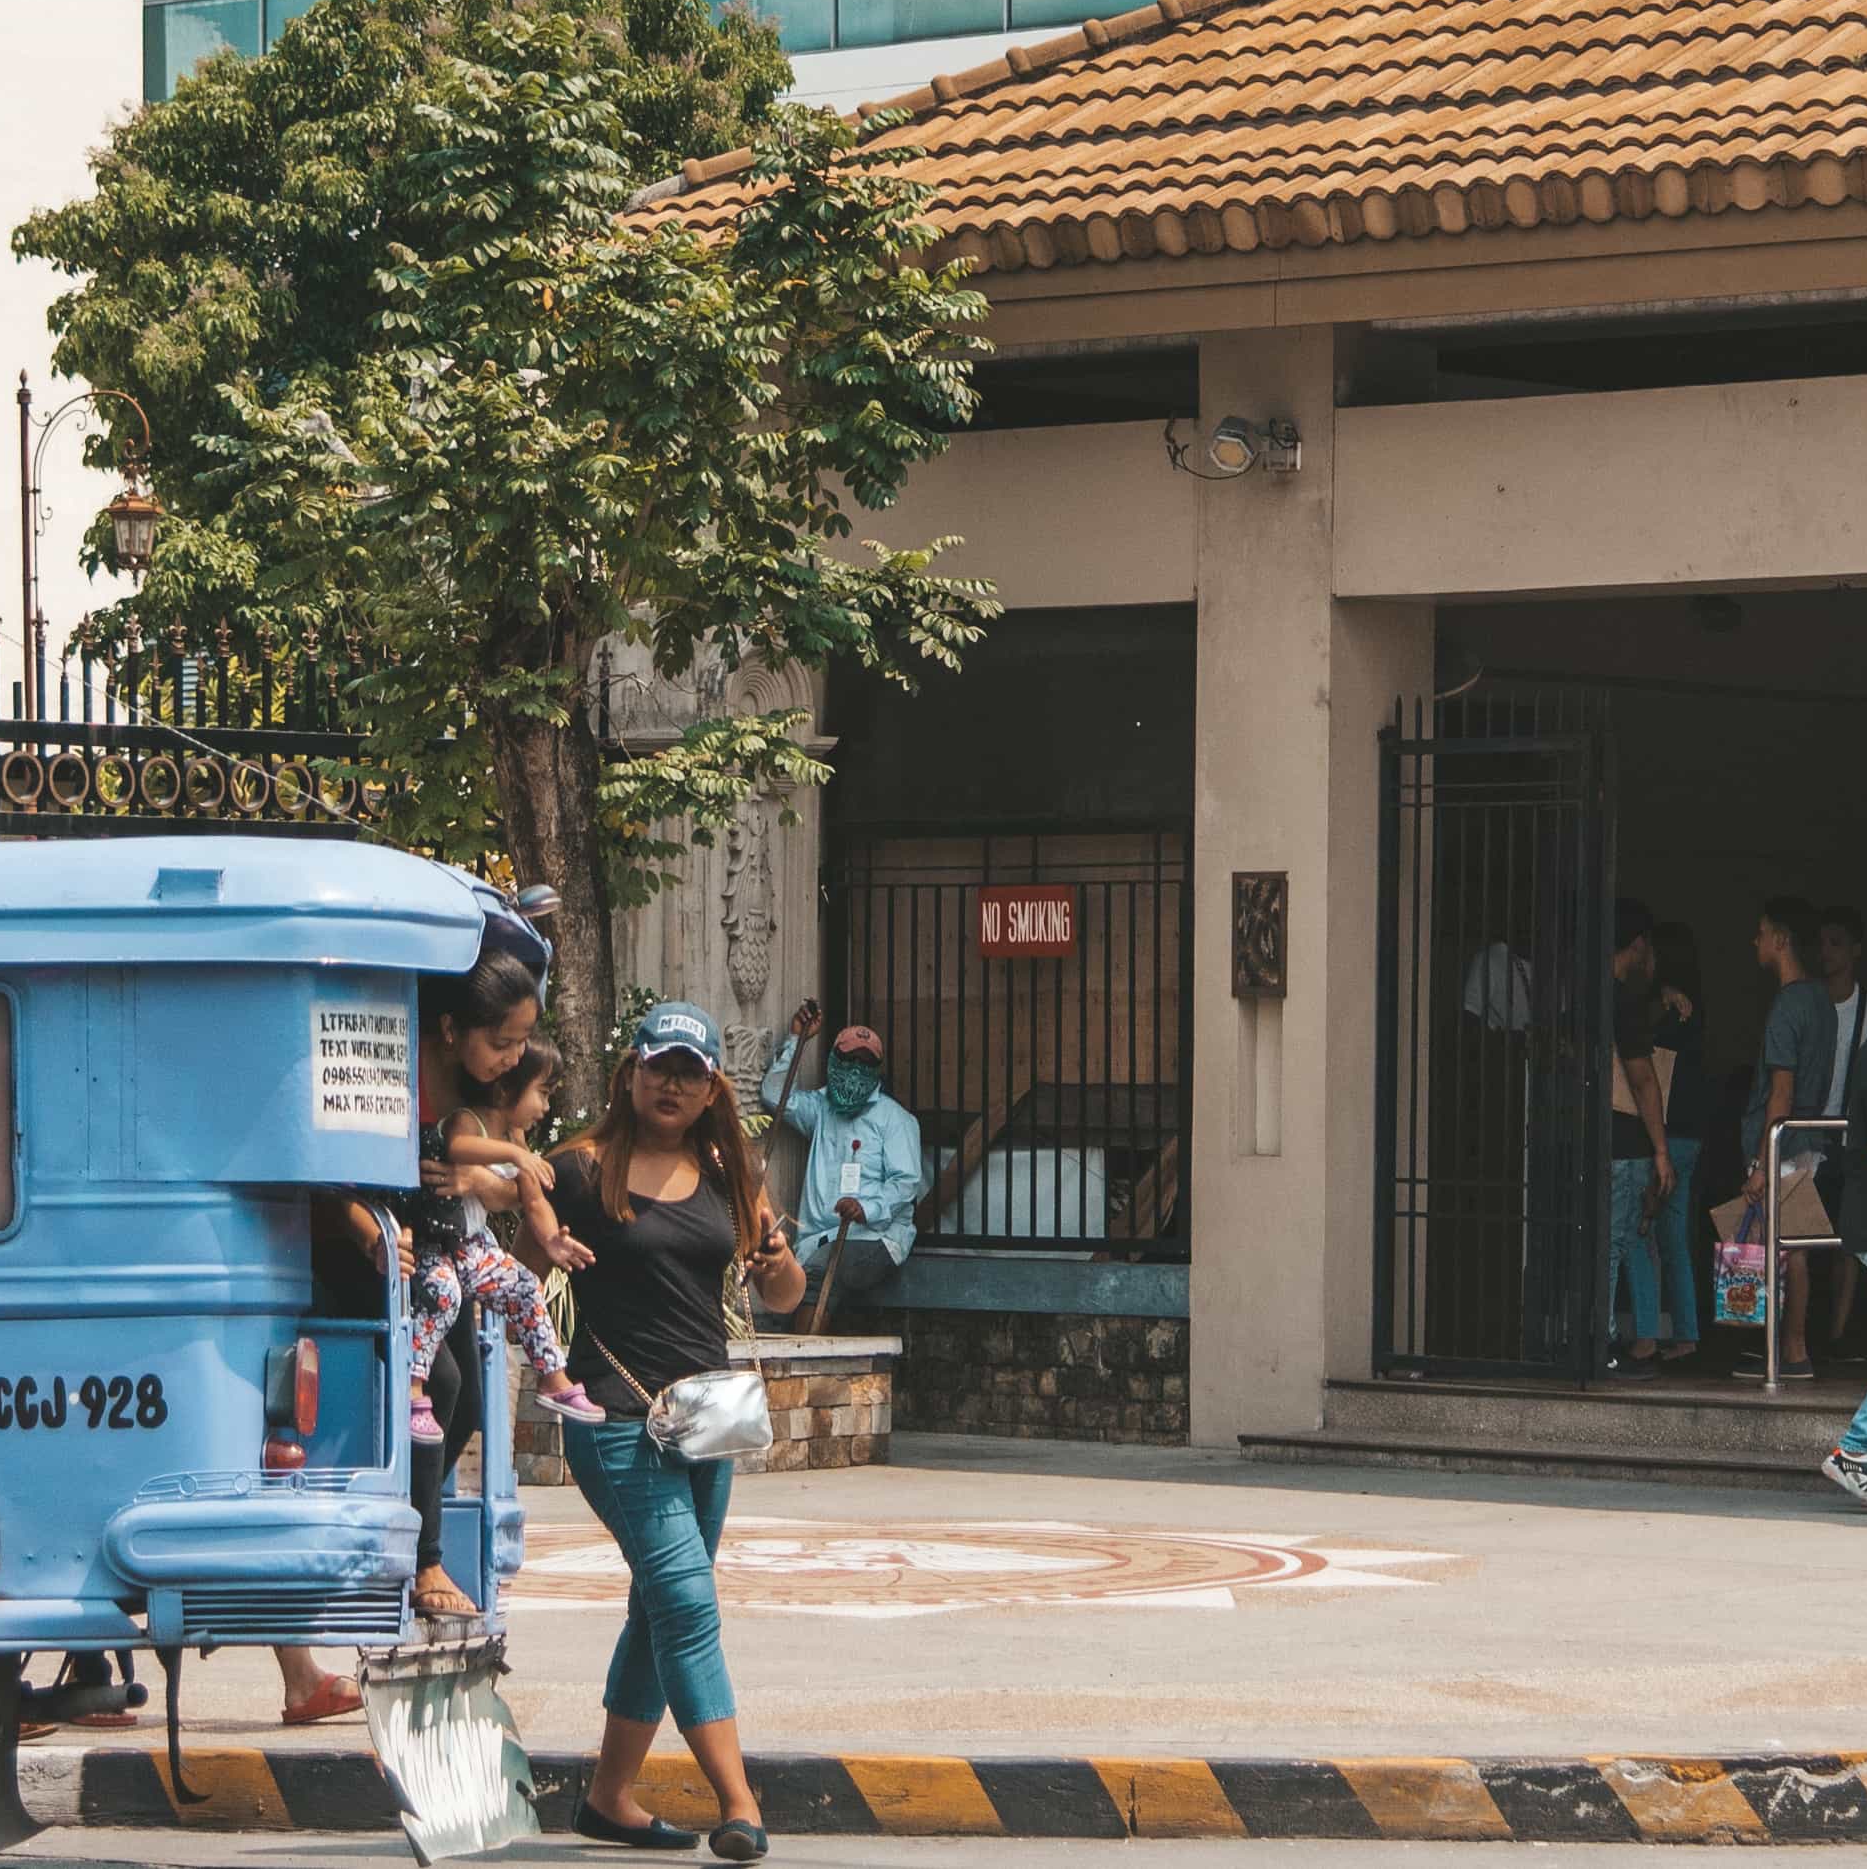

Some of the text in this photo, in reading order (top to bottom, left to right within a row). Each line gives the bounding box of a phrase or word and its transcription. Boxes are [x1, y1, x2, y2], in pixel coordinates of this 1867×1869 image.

[981, 900, 1070, 943] NO SMOKING
[320, 1039, 347, 1059] TEXT
[323, 1093, 351, 1113] MAX
[79, 1374, 169, 1429] 928
